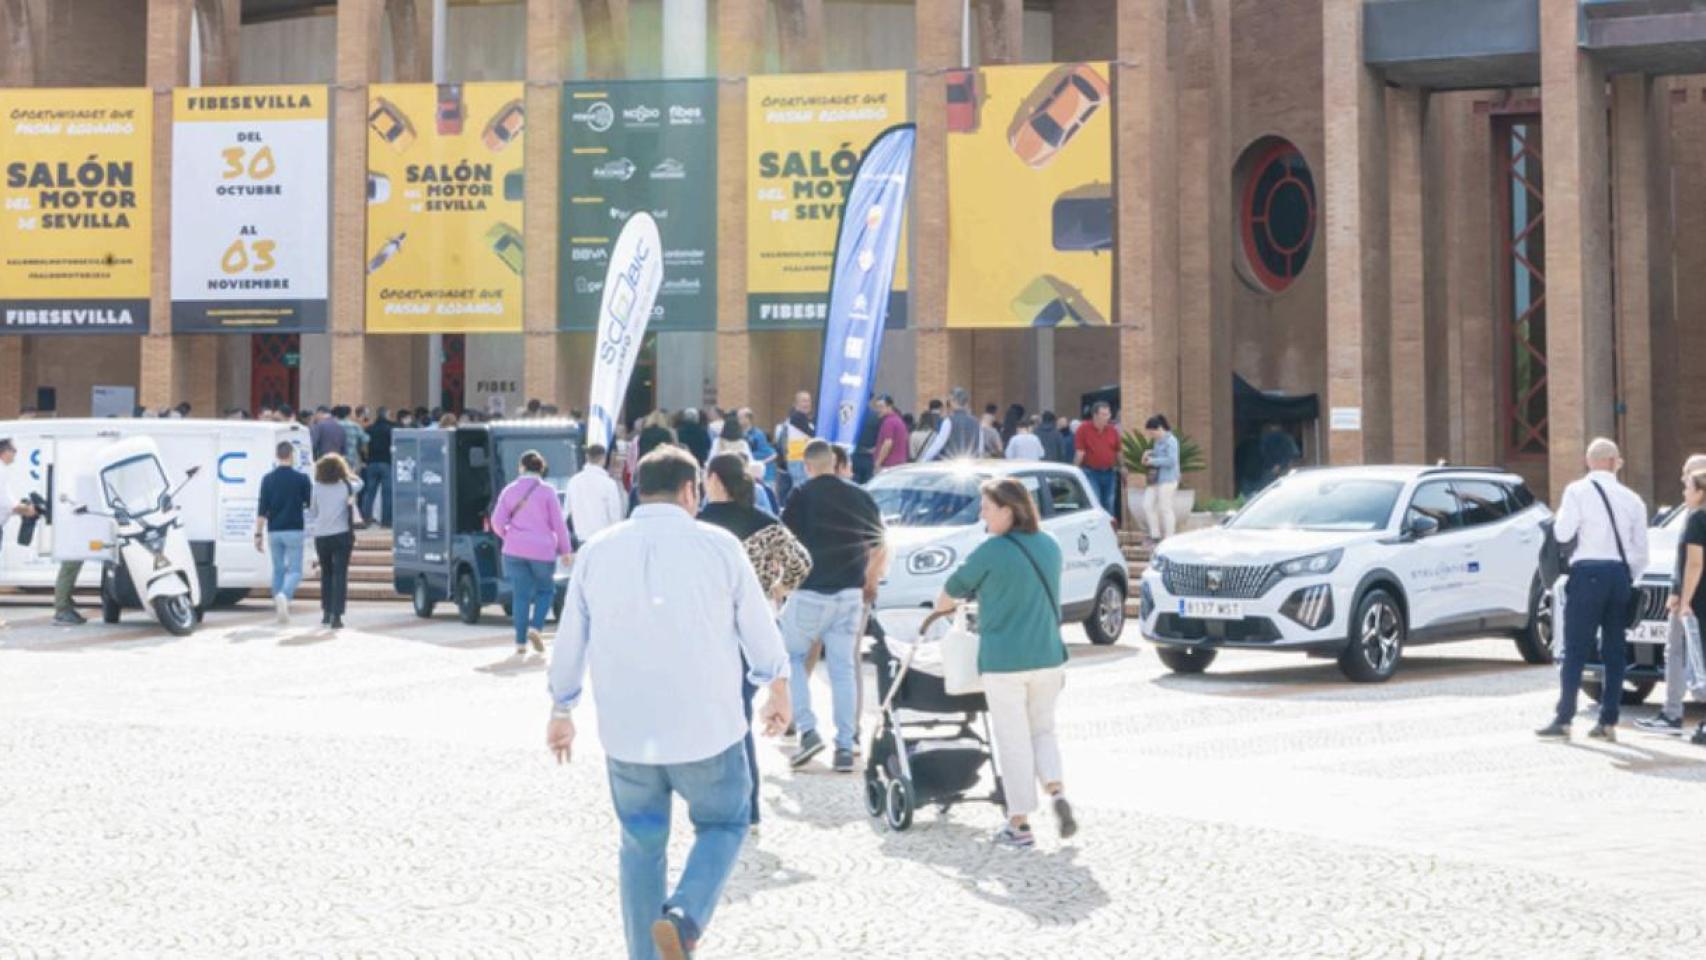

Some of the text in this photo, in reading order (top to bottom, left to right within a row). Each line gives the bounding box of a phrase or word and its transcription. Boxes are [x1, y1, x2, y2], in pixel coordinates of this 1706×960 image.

[187, 94, 311, 111] FIBESEVILLA
[236, 131, 262, 143] DEL
[221, 145, 277, 181] 30
[758, 142, 866, 179] SALÓ
[6, 153, 134, 189] SALÓN
[405, 158, 492, 183] SALÓN
[216, 184, 282, 196] OCTUBRE
[426, 184, 494, 197] MOTOR
[39, 190, 137, 209] MOTOR
[425, 200, 487, 212] SEVILLA
[41, 212, 131, 229] SEVILLA
[239, 225, 258, 236] AL
[221, 239, 277, 275] 03
[207, 278, 291, 290] NOVIEMBRE
[6, 308, 134, 325] FIBESEVILLA
